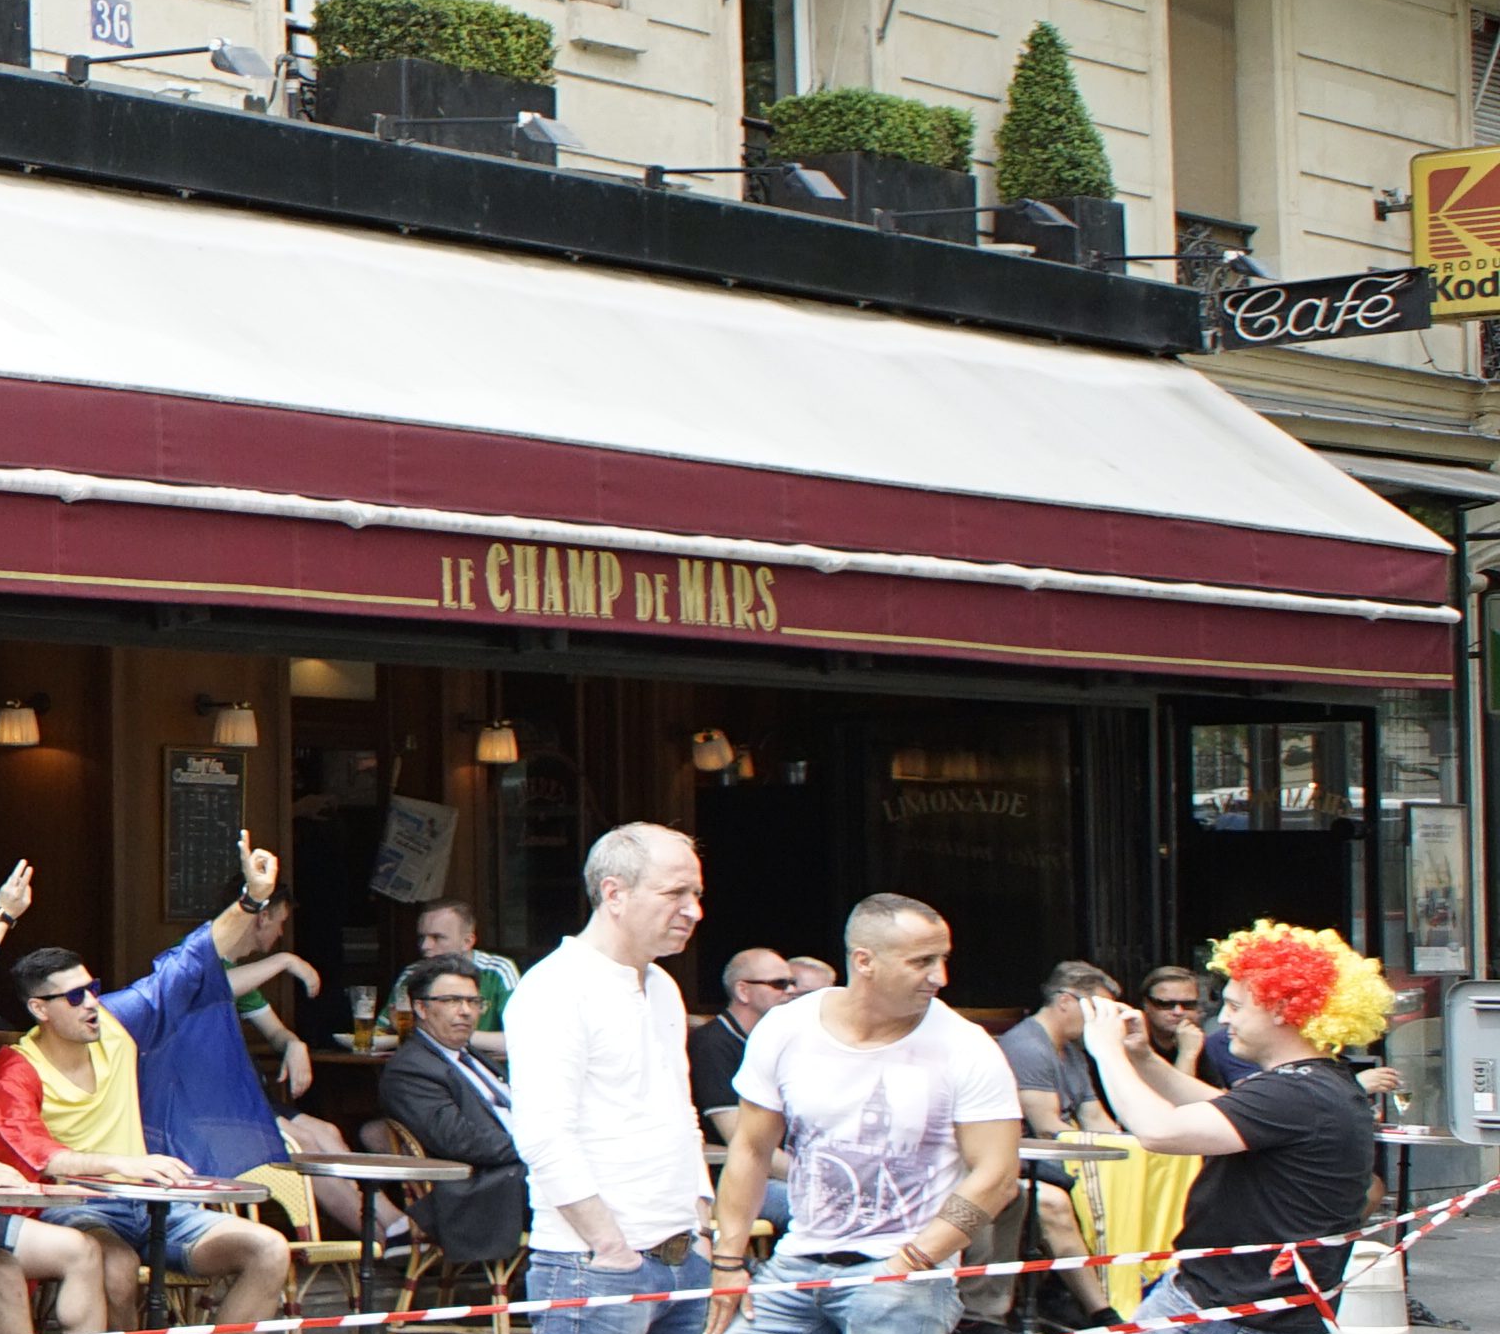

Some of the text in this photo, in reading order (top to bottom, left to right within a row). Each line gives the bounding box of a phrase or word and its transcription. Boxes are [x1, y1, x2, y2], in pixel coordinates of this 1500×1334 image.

[1223, 273, 1411, 343] Café
[441, 542, 779, 632] LE CHAMP DE MARS
[882, 788, 1028, 822] LIMONADE
